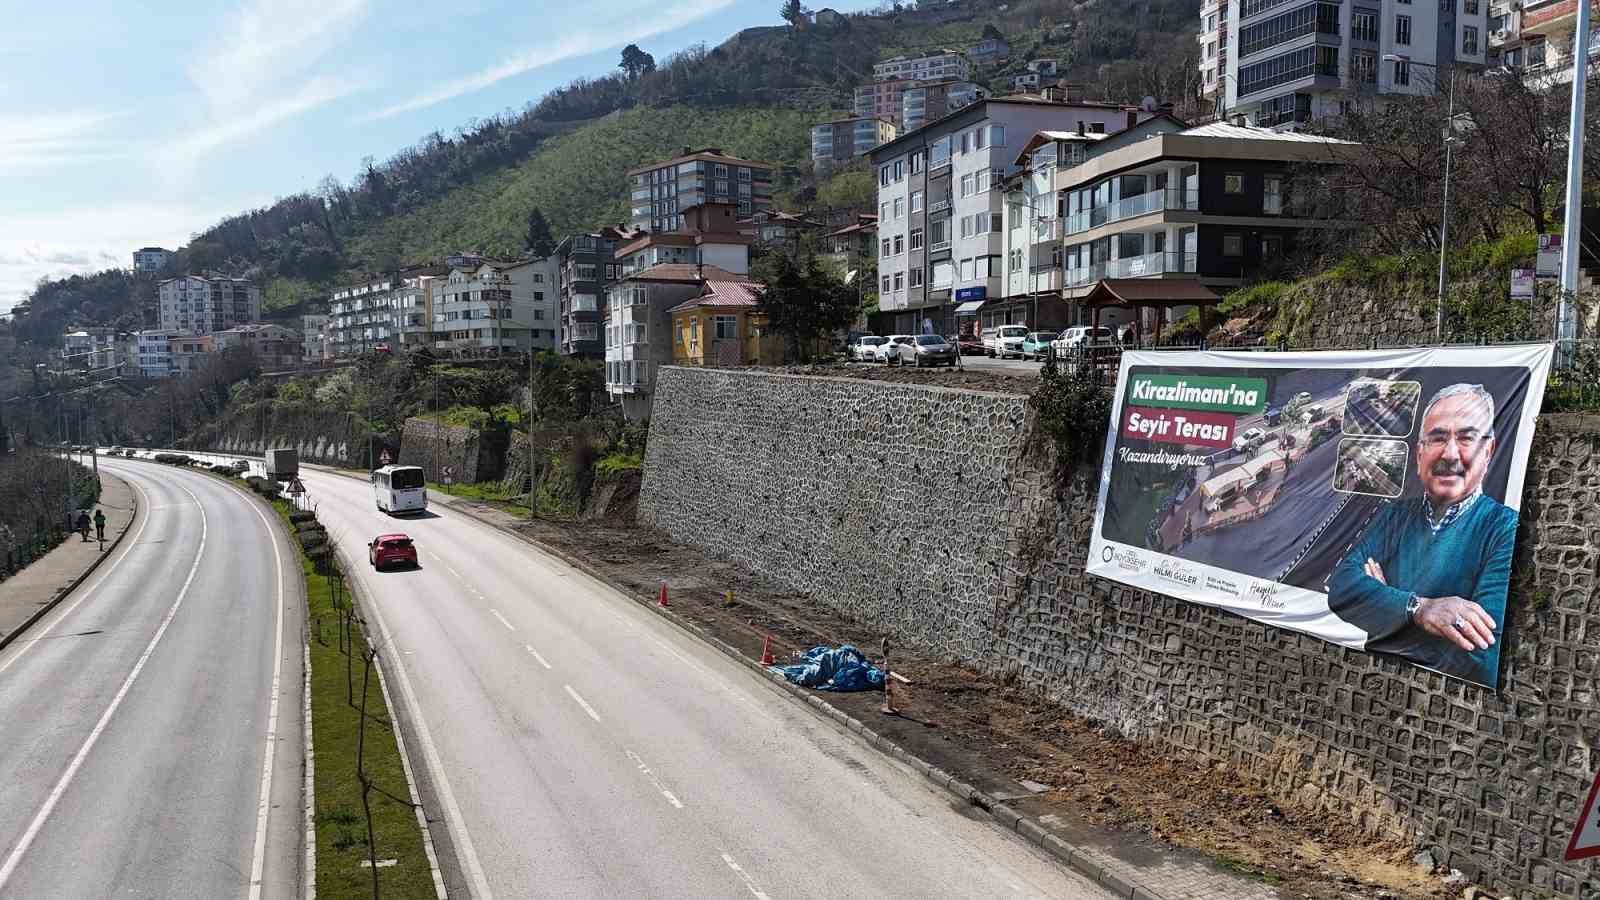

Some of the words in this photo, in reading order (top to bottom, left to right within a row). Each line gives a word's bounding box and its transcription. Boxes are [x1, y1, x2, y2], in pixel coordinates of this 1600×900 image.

[1132, 379, 1258, 407] Kirazlimanı'na
[1127, 412, 1171, 438] Seyir
[1174, 416, 1229, 441] Terası
